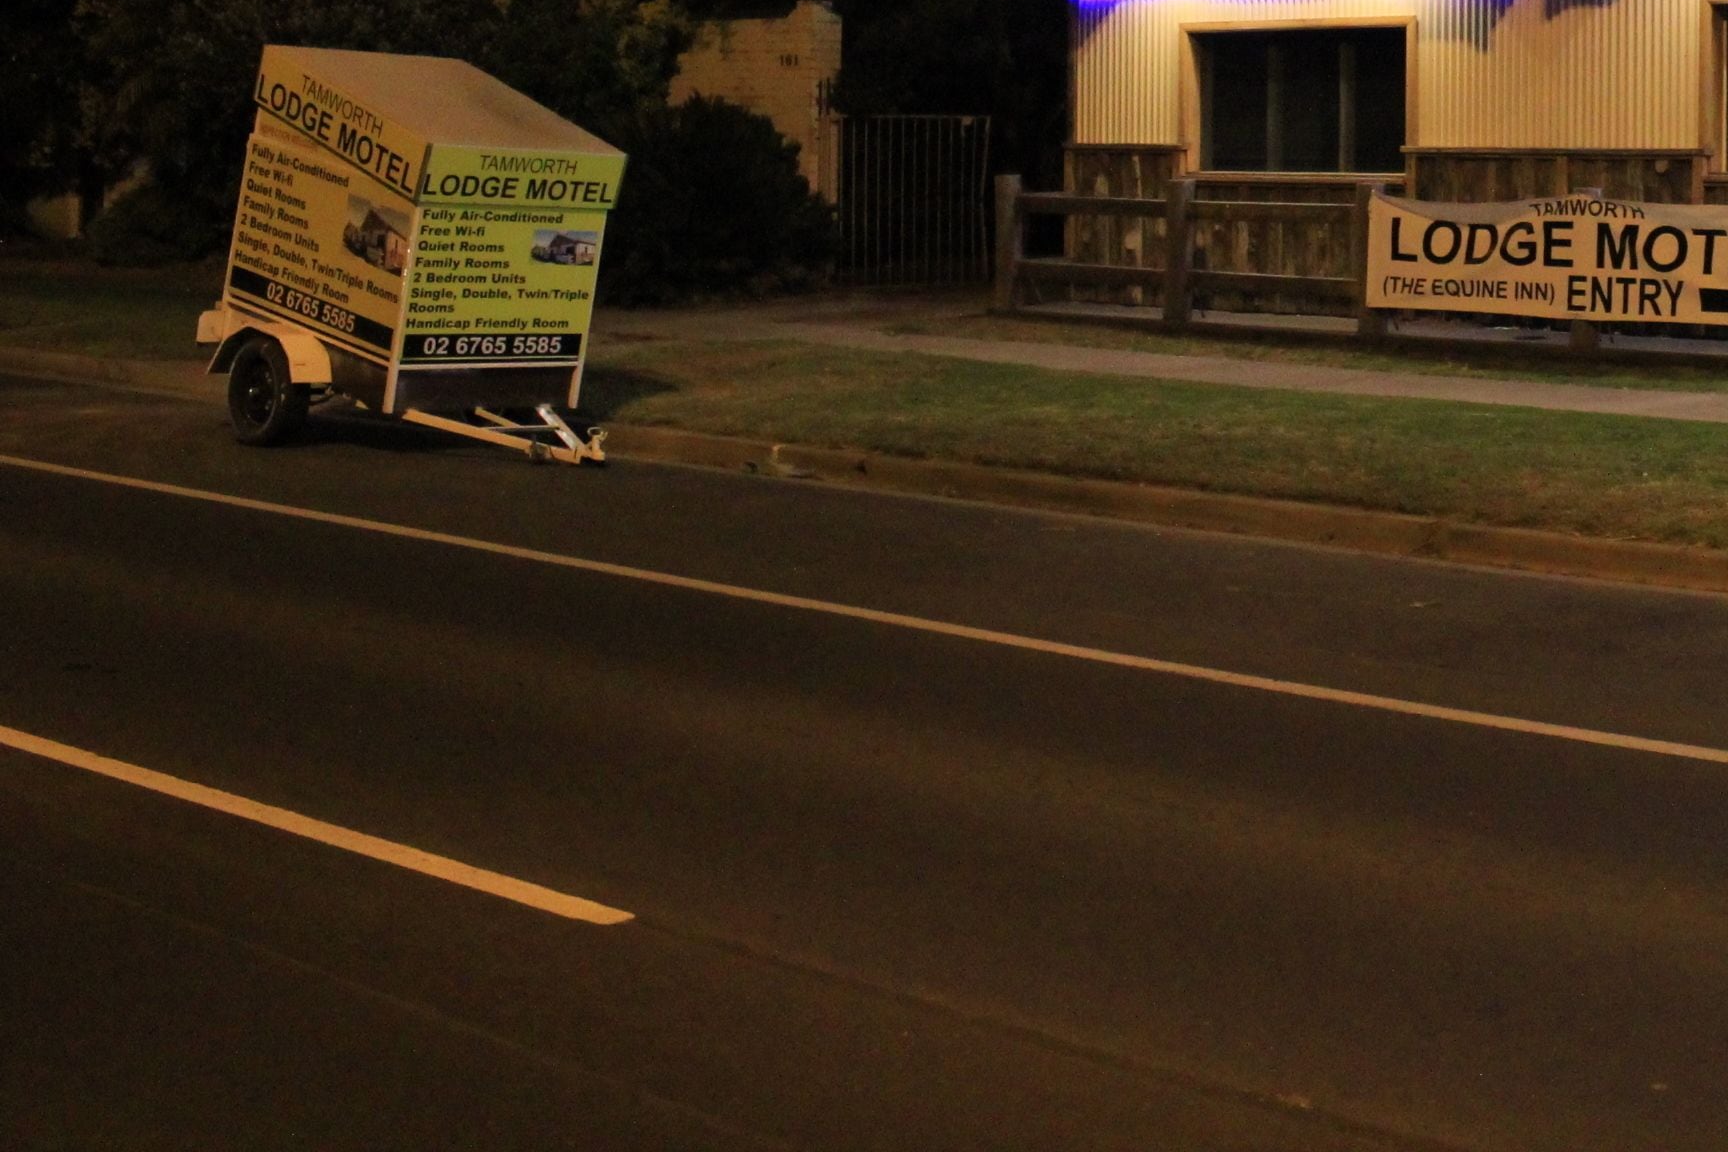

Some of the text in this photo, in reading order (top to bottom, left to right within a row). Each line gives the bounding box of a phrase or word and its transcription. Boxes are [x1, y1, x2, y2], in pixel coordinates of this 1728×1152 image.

[303, 74, 383, 138] TAMWORTH
[257, 74, 413, 194] LODGE MOTEL
[249, 161, 270, 178] Free
[252, 144, 349, 187] Fully Air-Conditioned
[480, 155, 578, 174] TAMWORTH
[247, 179, 306, 210] Quiet Rooms
[422, 174, 612, 203] LODGE MOTEL
[243, 196, 309, 229] Family Rooms
[423, 210, 563, 223] Fully Air-Conditioned
[1530, 200, 1645, 220] TAMWORTH
[241, 214, 319, 252] 2 Bedroom Units
[420, 226, 484, 236] Free Wi-fi
[1390, 217, 1574, 268] LODGE
[419, 241, 504, 252] Quiet Rooms
[235, 250, 348, 303] Handicap Friendly Room
[238, 232, 398, 303] Single, Double, Twin/Triple Rooms
[414, 273, 525, 284] 2 Bedroom Units
[416, 258, 510, 270] Family Rooms
[411, 288, 589, 301] Single, Double, Twin/Triple
[1383, 276, 1555, 305] (THE EQUINE INN)
[1567, 274, 1684, 316] ENTRY
[267, 283, 355, 332] 02 6765 5585
[409, 303, 454, 313] Rooms
[406, 318, 569, 330] Handicap Friendly Room
[424, 336, 562, 355] 02 6765 5585
